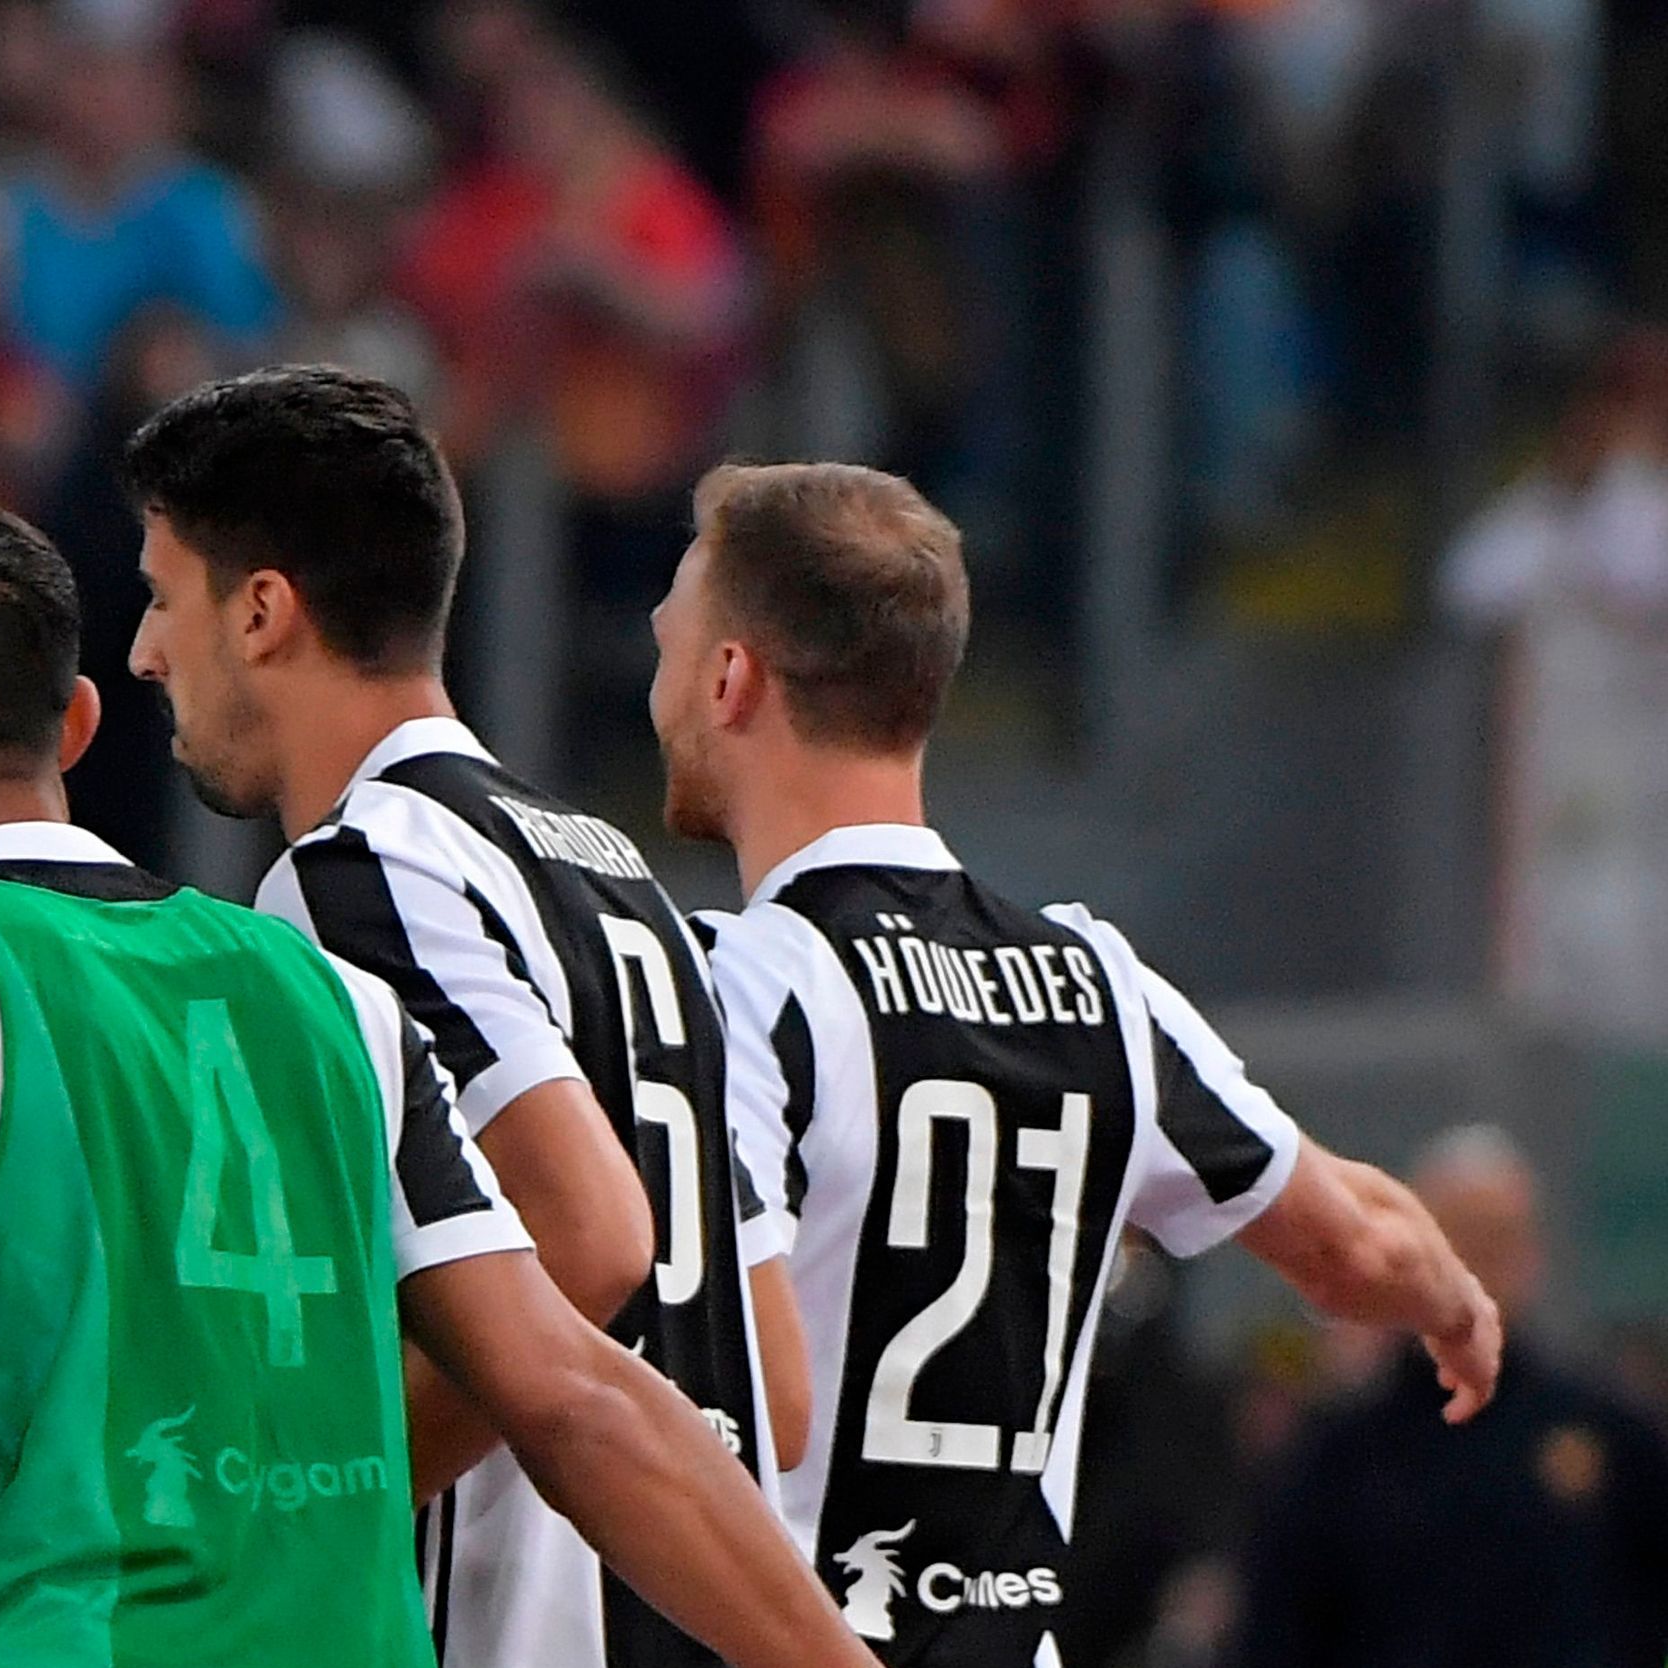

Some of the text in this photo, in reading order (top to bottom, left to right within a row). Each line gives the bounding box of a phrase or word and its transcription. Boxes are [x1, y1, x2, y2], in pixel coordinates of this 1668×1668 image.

[599, 913, 702, 1304] 6
[853, 914, 1105, 1026] HÖWEDES
[175, 998, 337, 1367] 4
[862, 1079, 1090, 1475] 21
